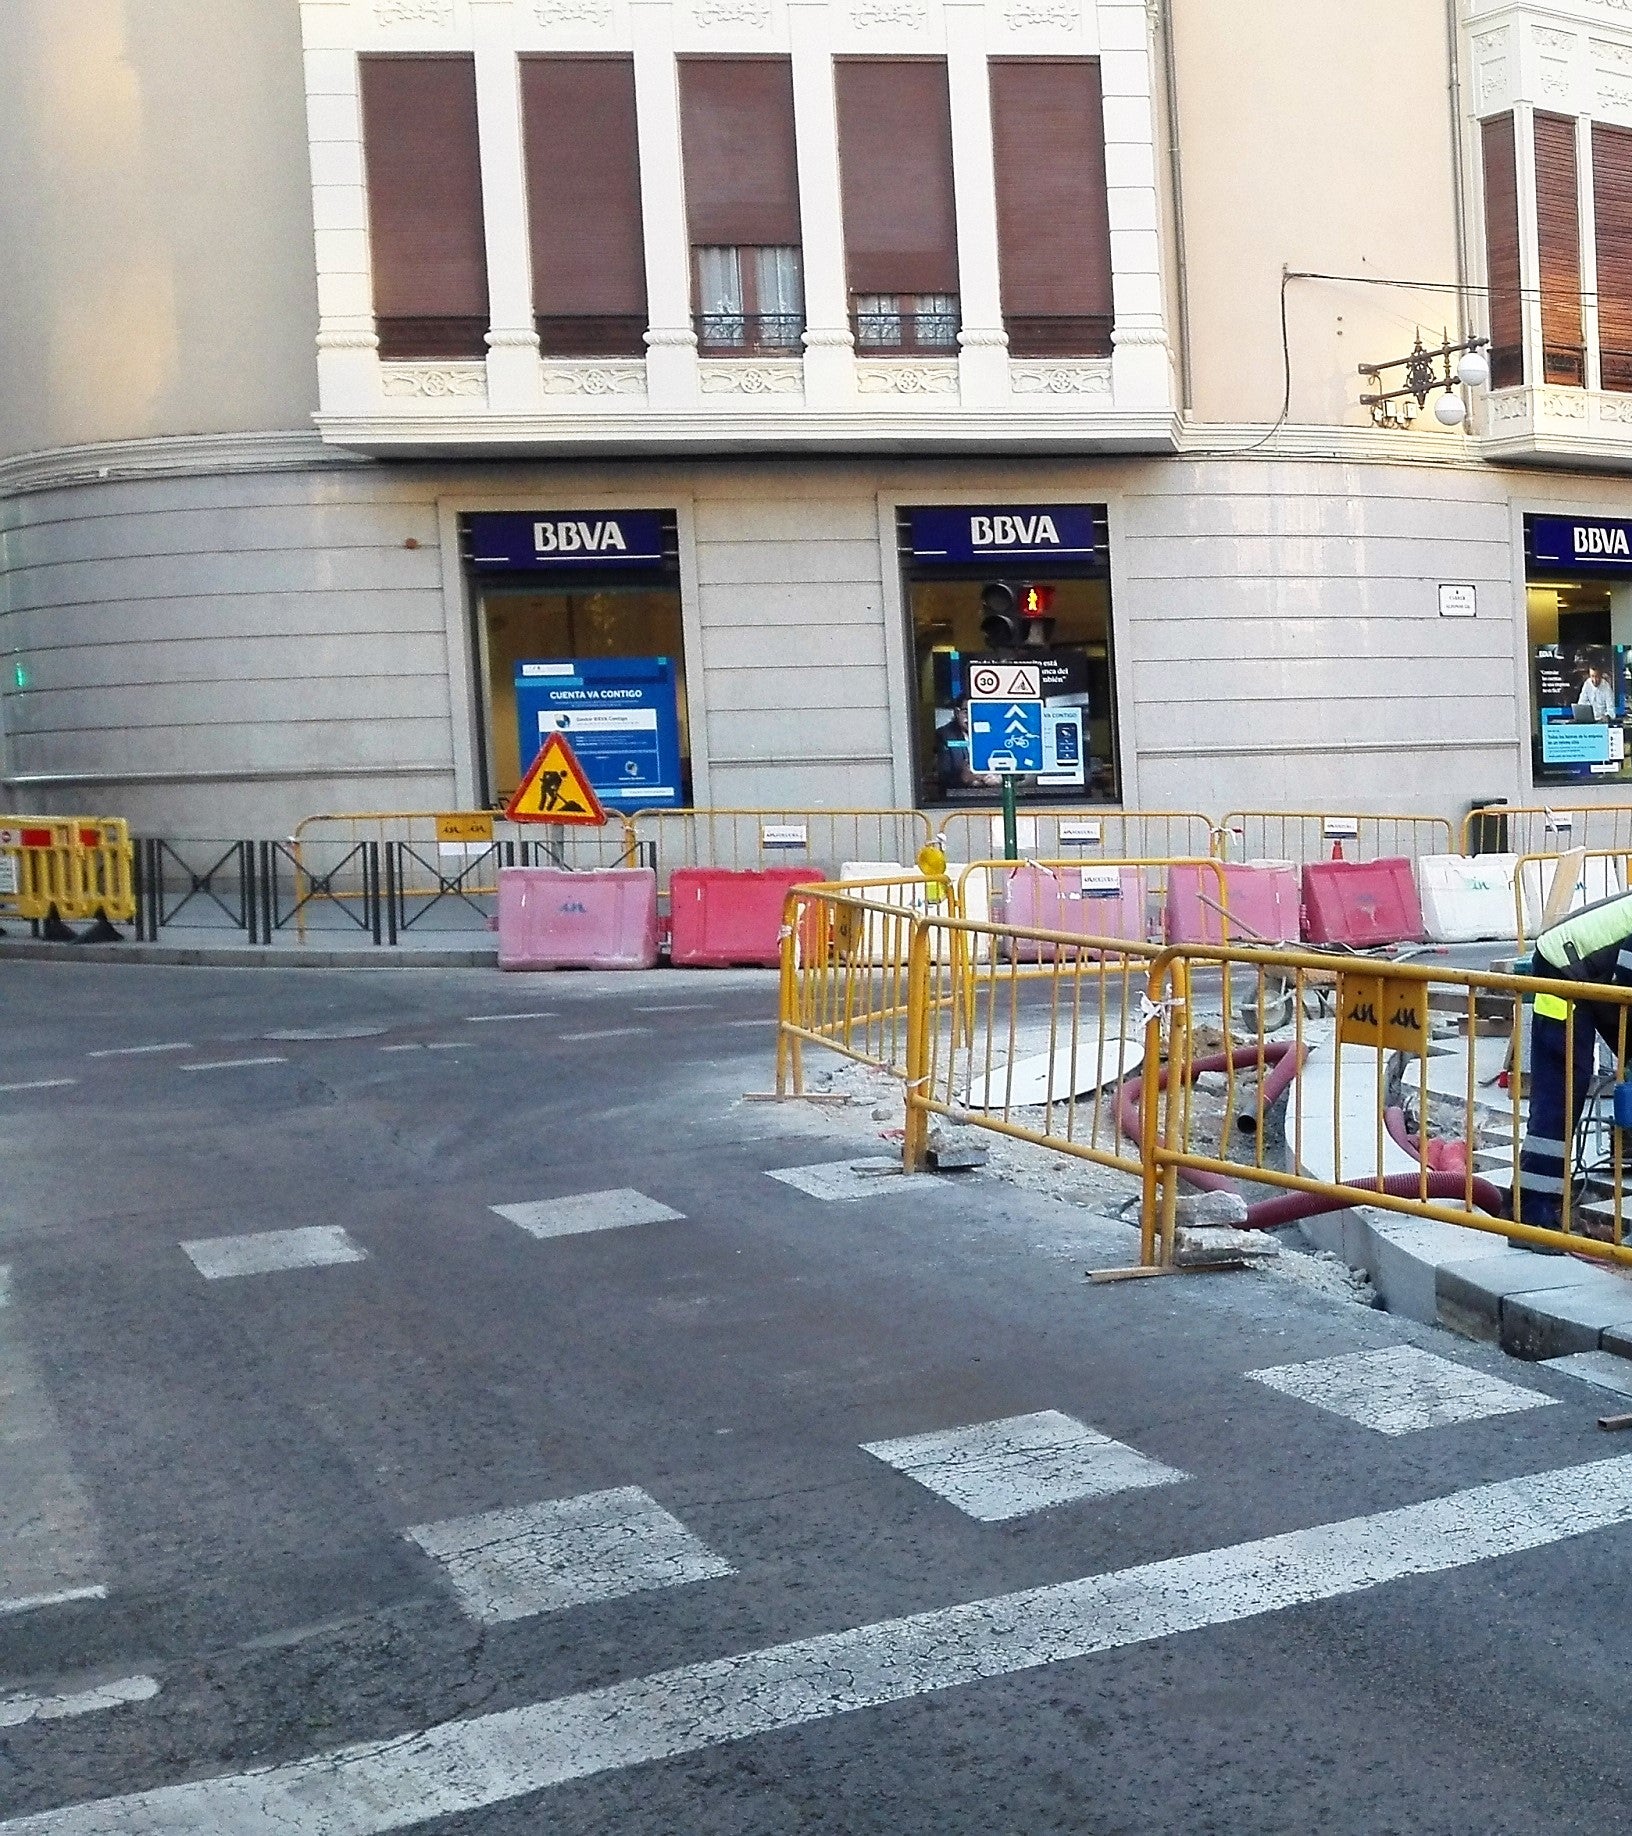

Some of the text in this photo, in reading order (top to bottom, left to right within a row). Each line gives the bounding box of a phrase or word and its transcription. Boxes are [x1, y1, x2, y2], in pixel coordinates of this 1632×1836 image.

[533, 521, 626, 551] BBVA
[970, 515, 1060, 545] BBVA
[1573, 526, 1630, 555] BBVA
[550, 689, 643, 700] CUENTA VA CONTIGO
[979, 677, 994, 686] 30
